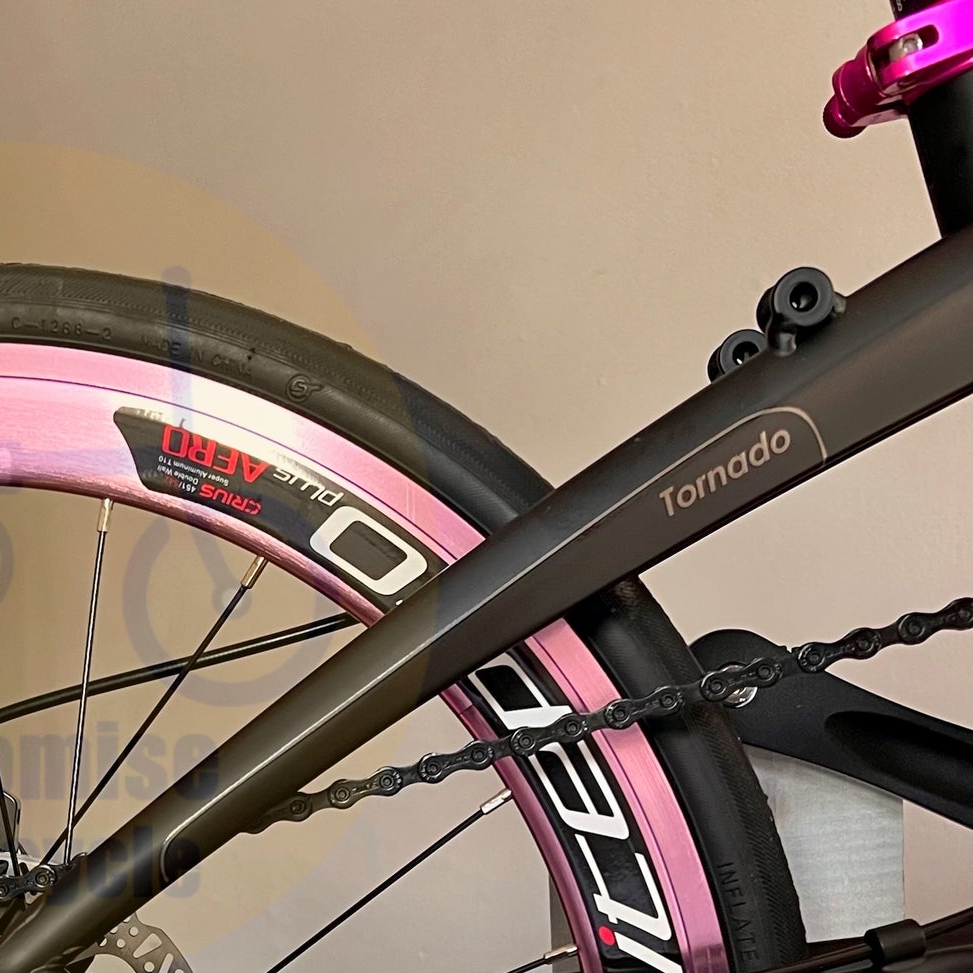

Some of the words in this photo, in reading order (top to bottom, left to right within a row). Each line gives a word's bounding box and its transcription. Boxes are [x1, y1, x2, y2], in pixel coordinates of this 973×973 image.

[199, 483, 262, 516] CRIUS
[659, 429, 791, 517] Tornado
[715, 859, 760, 964] INFLATE
